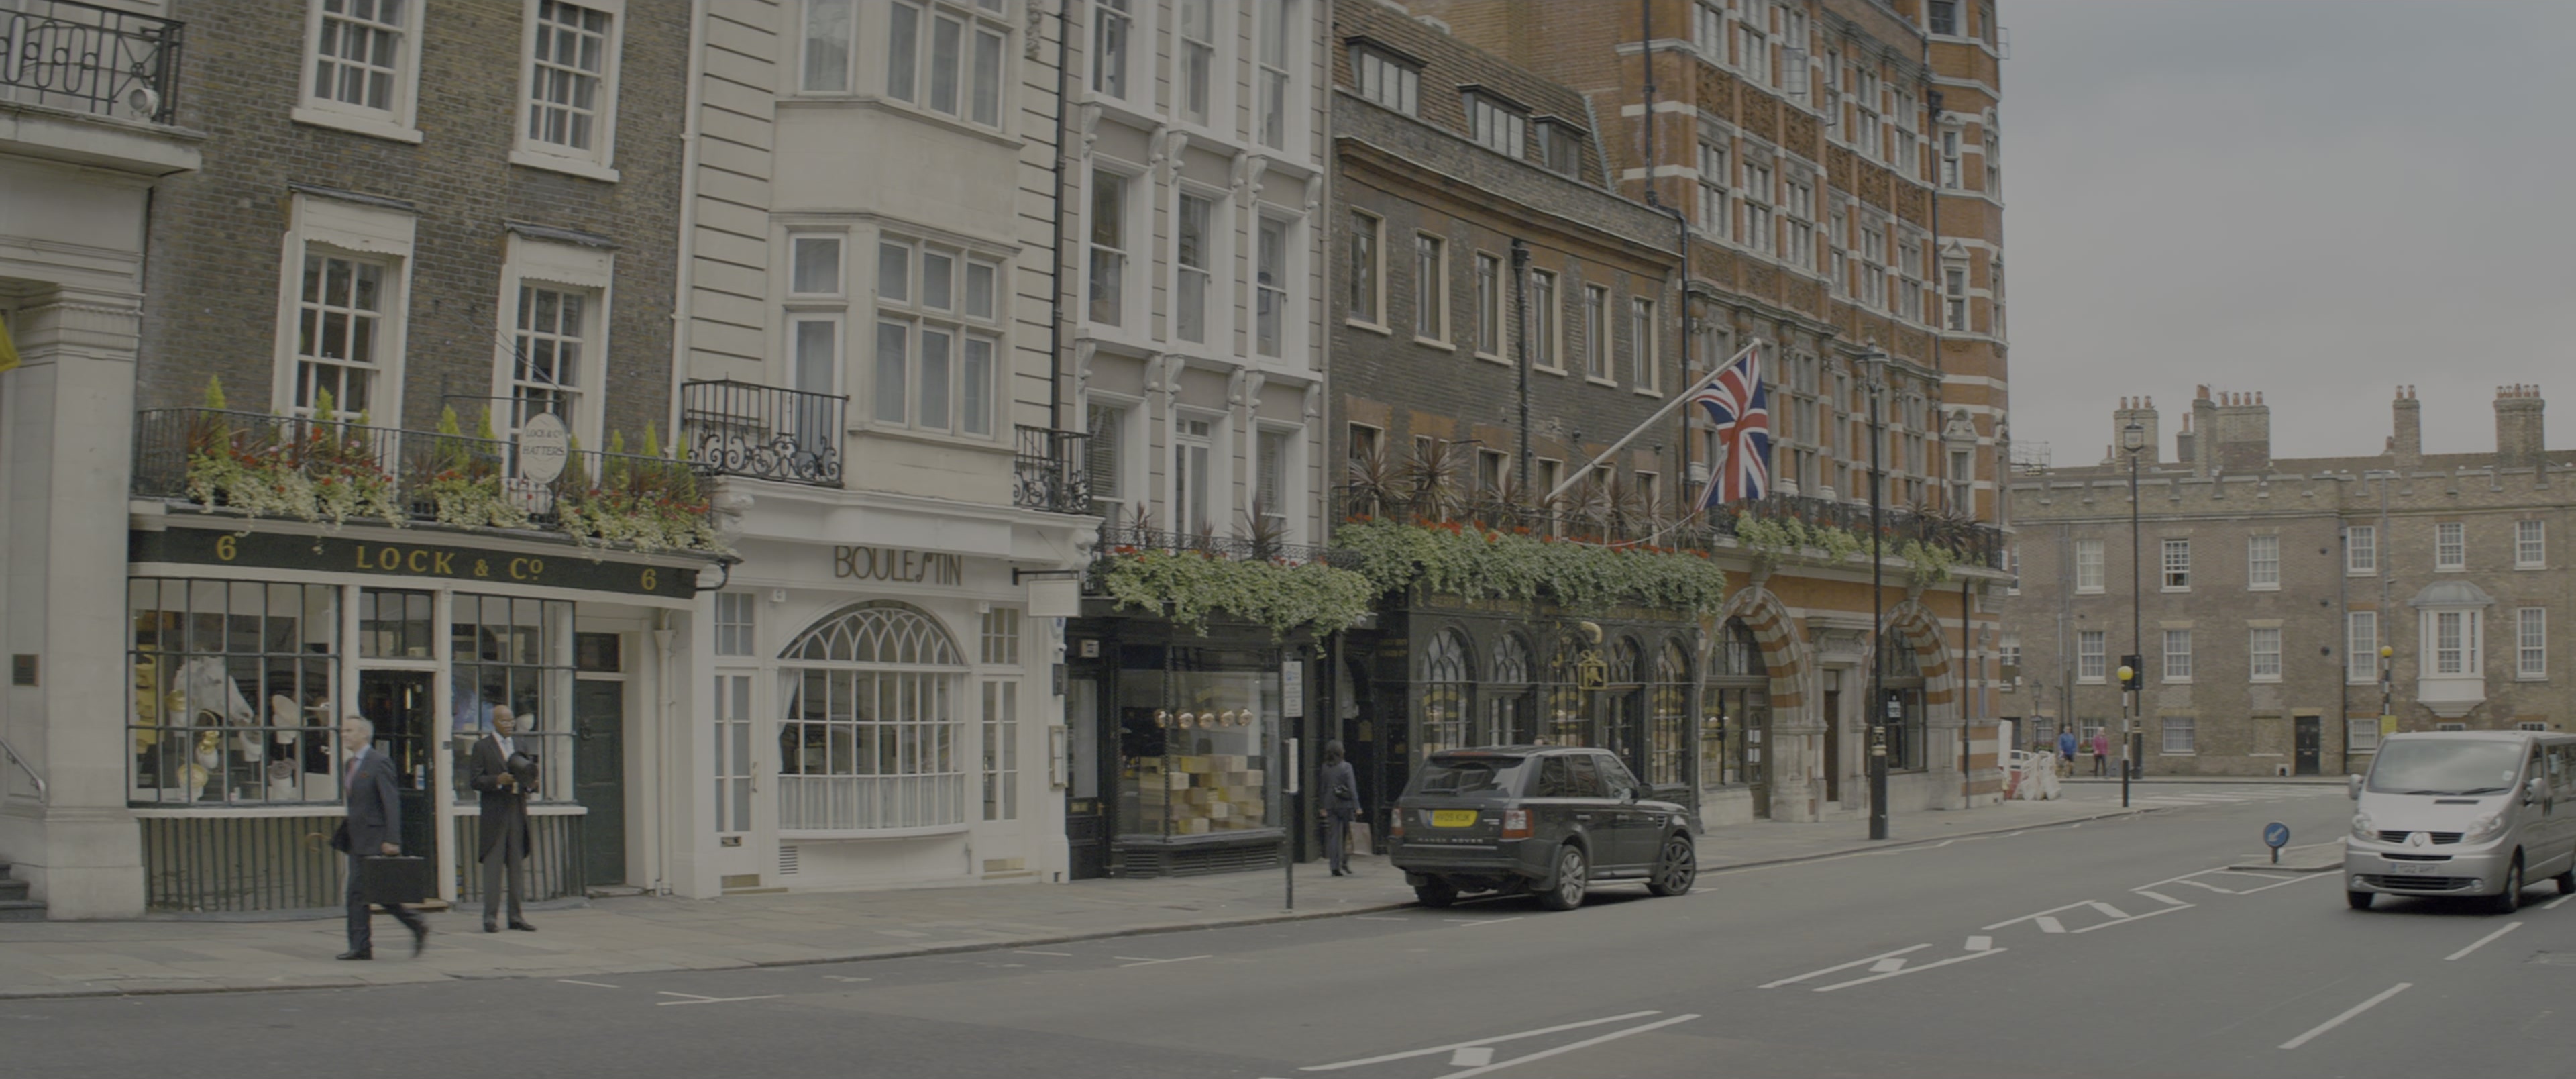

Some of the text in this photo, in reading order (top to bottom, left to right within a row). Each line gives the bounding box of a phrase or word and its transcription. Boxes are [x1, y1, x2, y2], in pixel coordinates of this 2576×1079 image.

[526, 429, 545, 438] LOCK
[547, 429, 553, 438] &
[523, 445, 565, 456] HATTERS
[215, 535, 237, 561] 6
[357, 545, 456, 575] LOCK
[474, 558, 489, 577] &
[835, 545, 962, 586] BOULESTIN
[641, 568, 657, 590] 6
